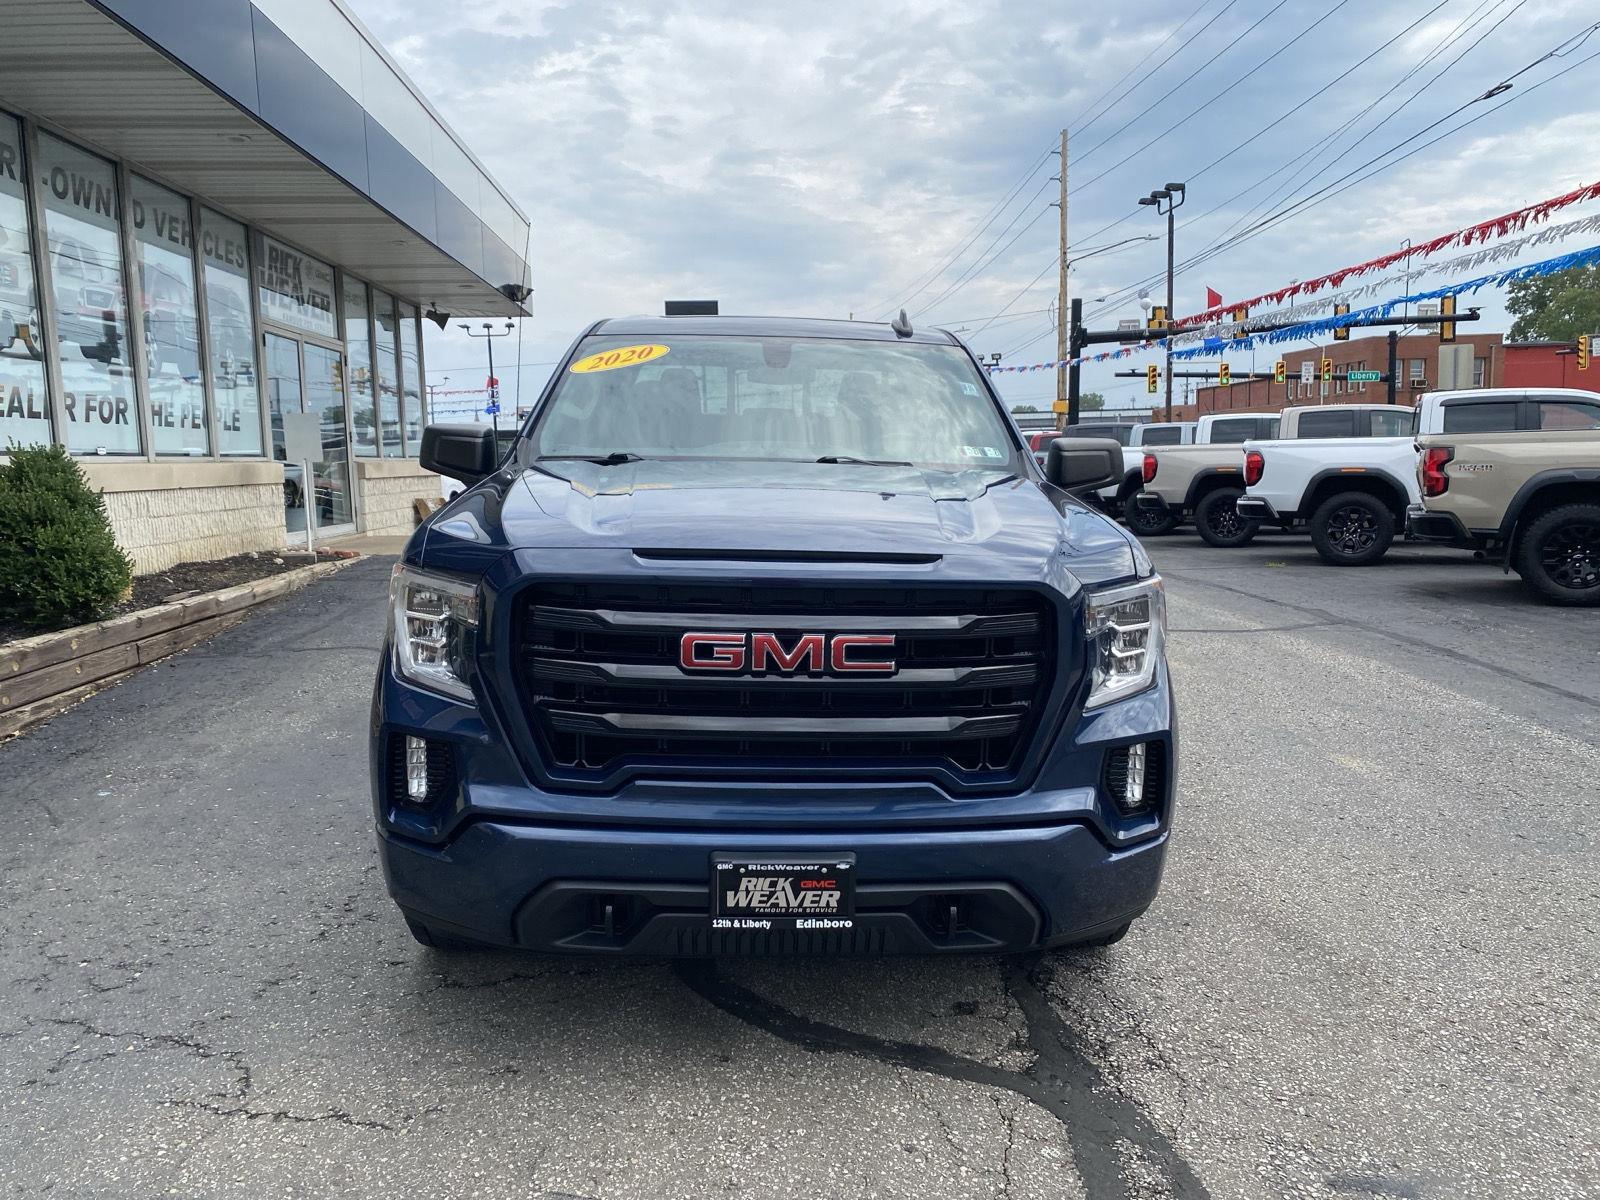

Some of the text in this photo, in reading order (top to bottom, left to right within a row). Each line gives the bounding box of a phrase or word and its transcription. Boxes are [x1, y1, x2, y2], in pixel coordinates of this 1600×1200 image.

[153, 208, 244, 269] VEHCLES
[587, 346, 653, 370] 2020
[1351, 371, 1376, 380] Liberty
[84, 393, 129, 425] FOR
[151, 402, 175, 428] HE
[681, 631, 896, 672] GMC
[739, 877, 836, 891] RICK GMC
[726, 890, 841, 908] WEAVER
[712, 919, 853, 930] 12th & Liberty Edinboro
